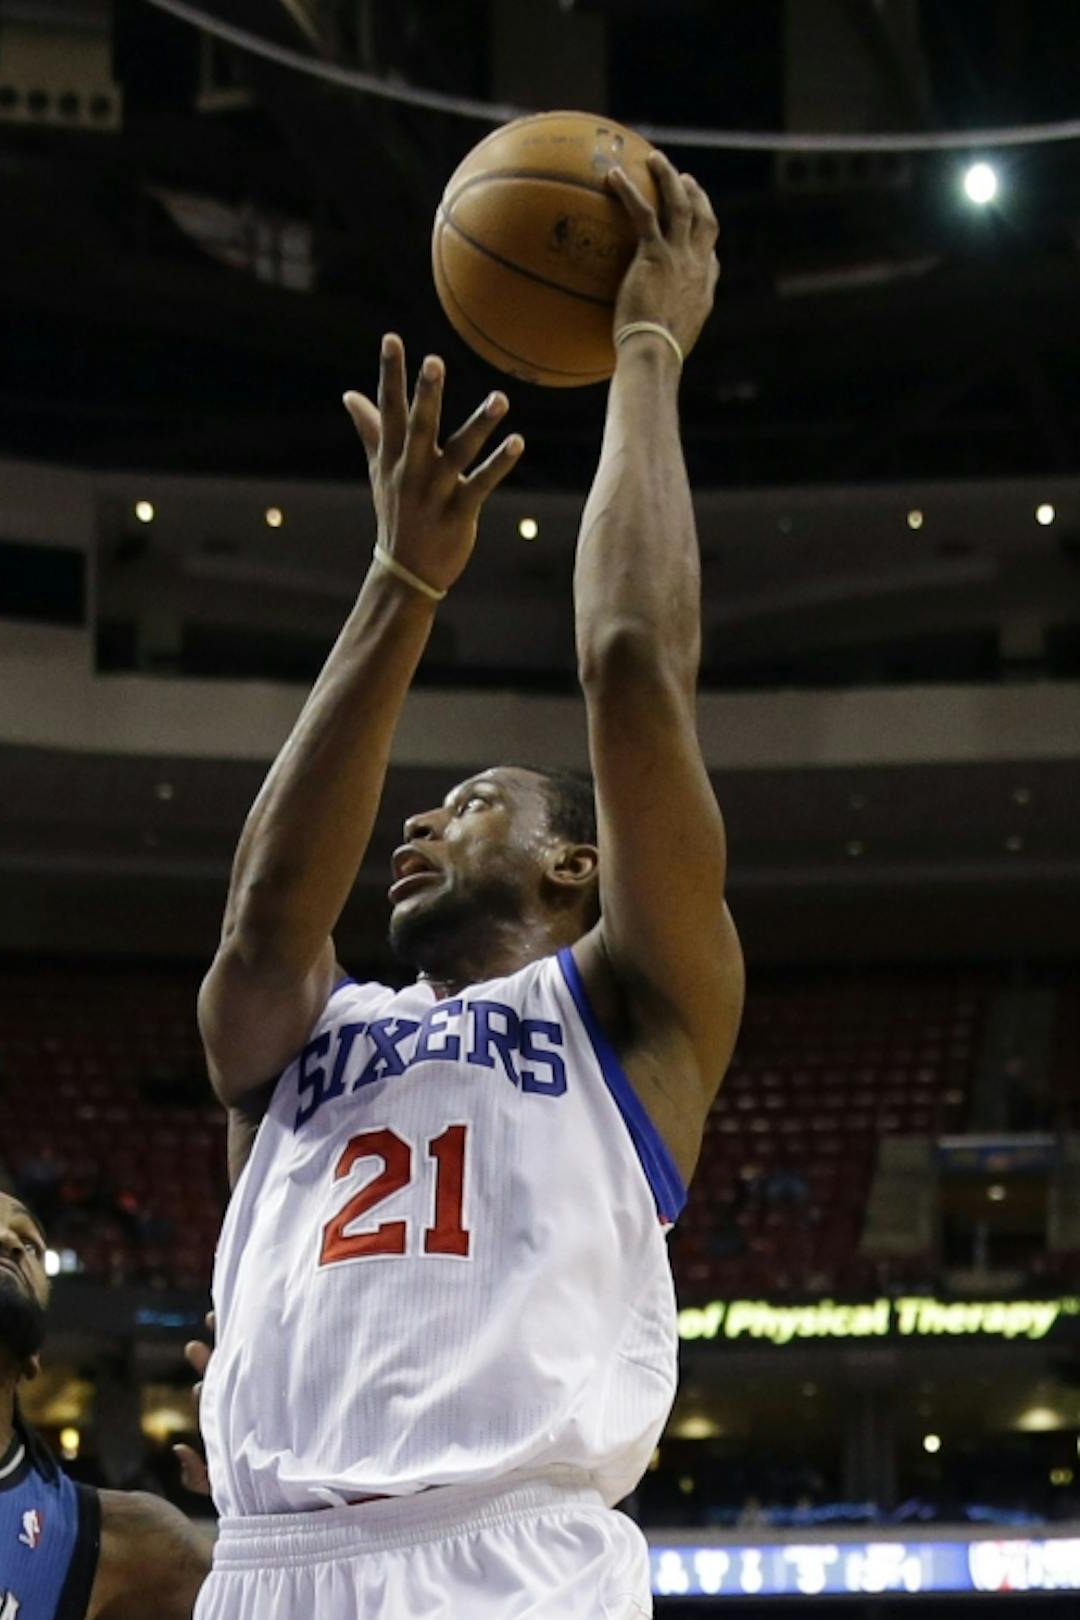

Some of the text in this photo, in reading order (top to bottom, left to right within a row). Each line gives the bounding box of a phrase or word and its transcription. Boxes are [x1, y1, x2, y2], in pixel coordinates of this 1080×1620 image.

[294, 1000, 567, 1134] SIXERS
[319, 1124, 469, 1267] 21
[678, 1302, 723, 1339] of
[726, 1300, 889, 1344] Physical
[896, 1298, 1060, 1339] Therapy
